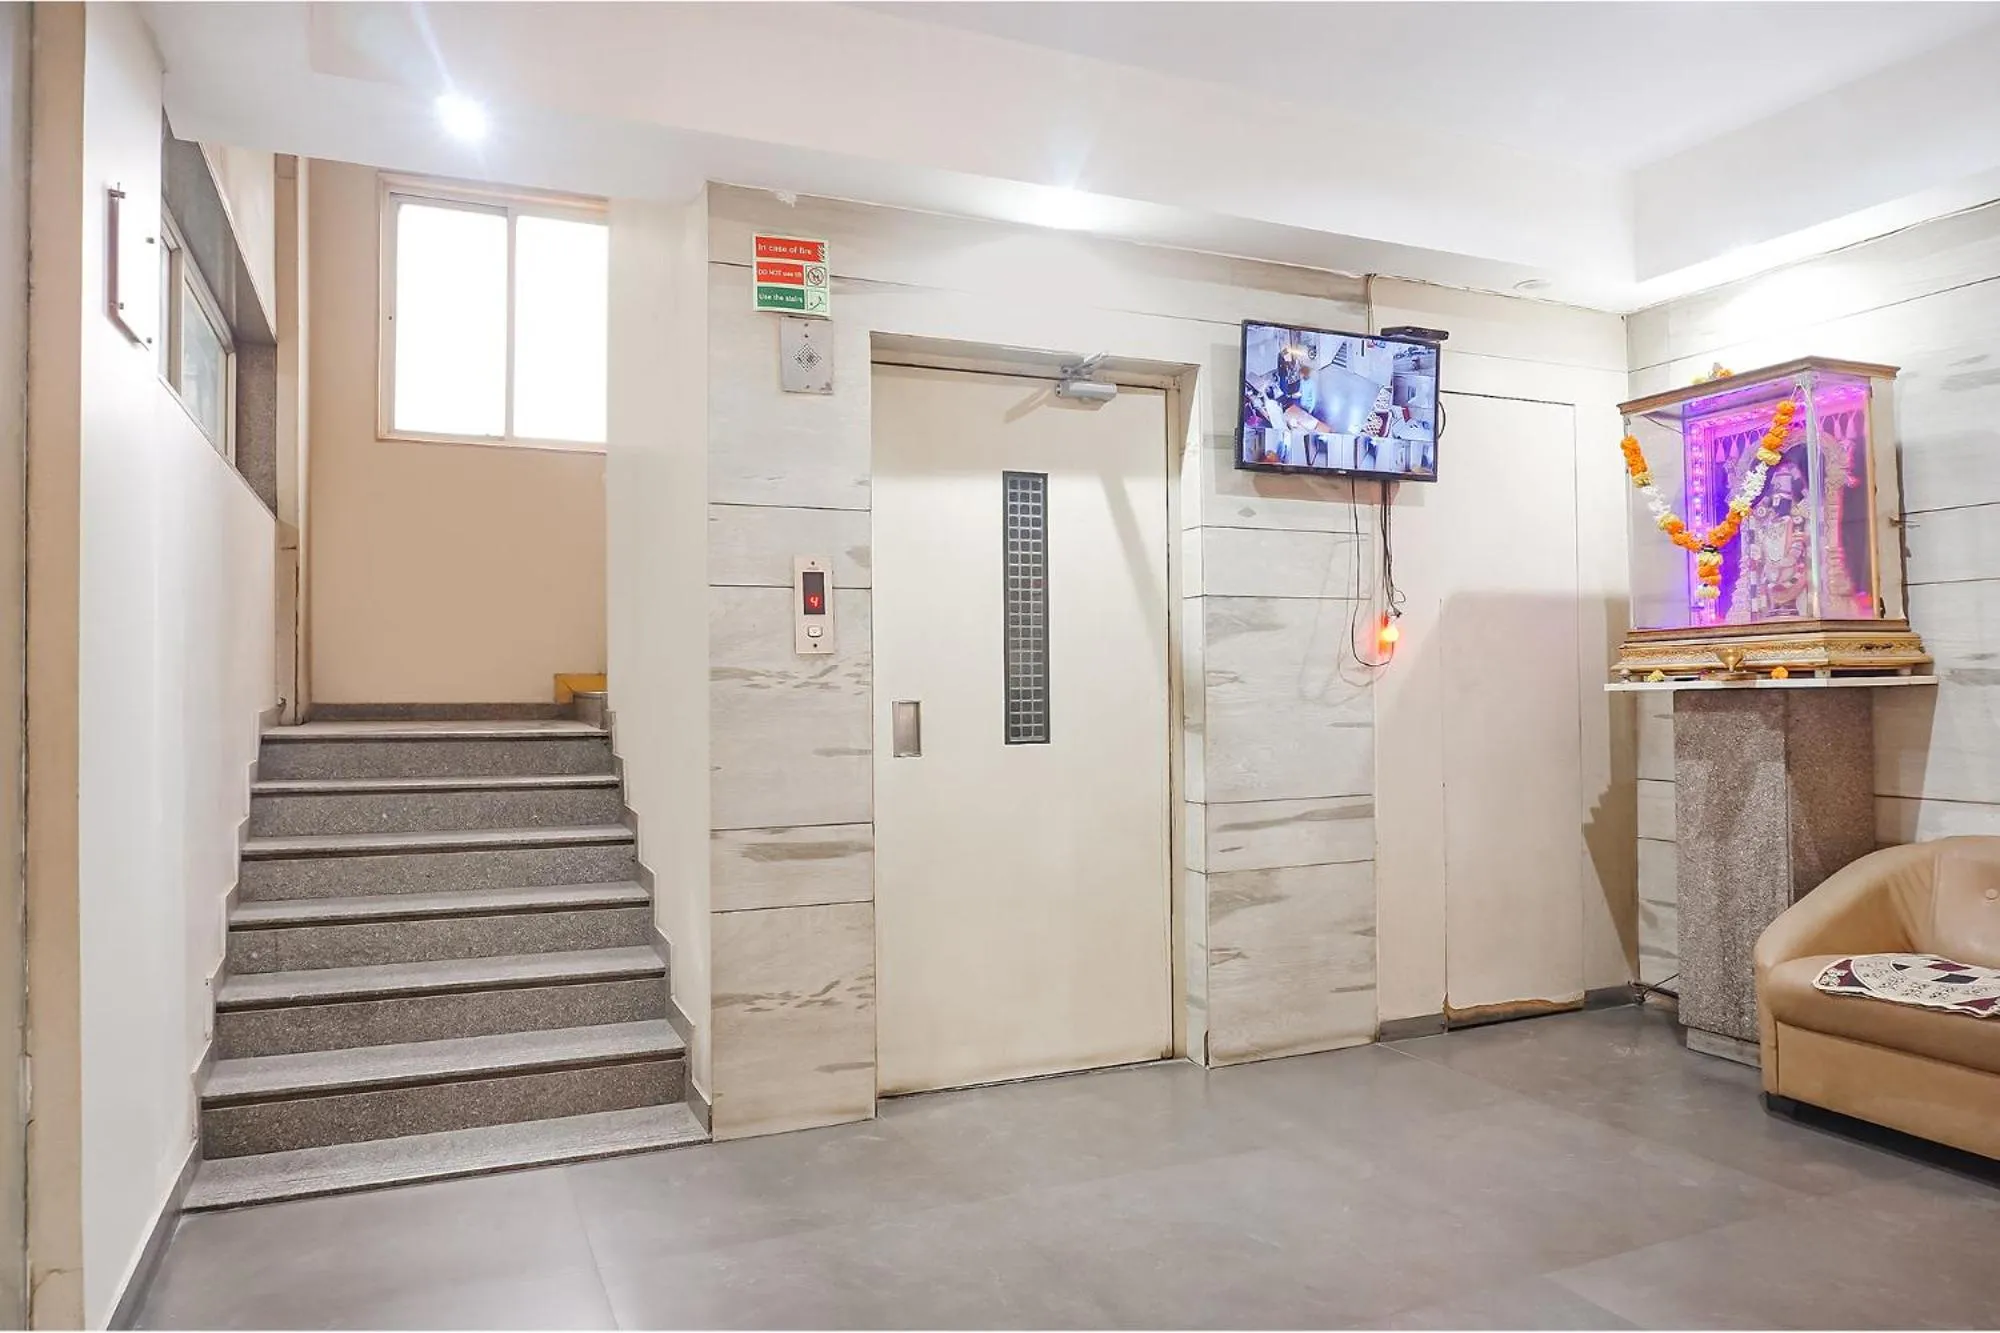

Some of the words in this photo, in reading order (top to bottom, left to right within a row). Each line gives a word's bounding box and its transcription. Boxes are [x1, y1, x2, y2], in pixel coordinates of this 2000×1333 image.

[758, 243, 766, 251] In
[768, 245, 788, 253] case
[789, 246, 797, 254] of
[799, 247, 812, 255] fire
[769, 268, 782, 276] NOT
[810, 596, 819, 608] 4
